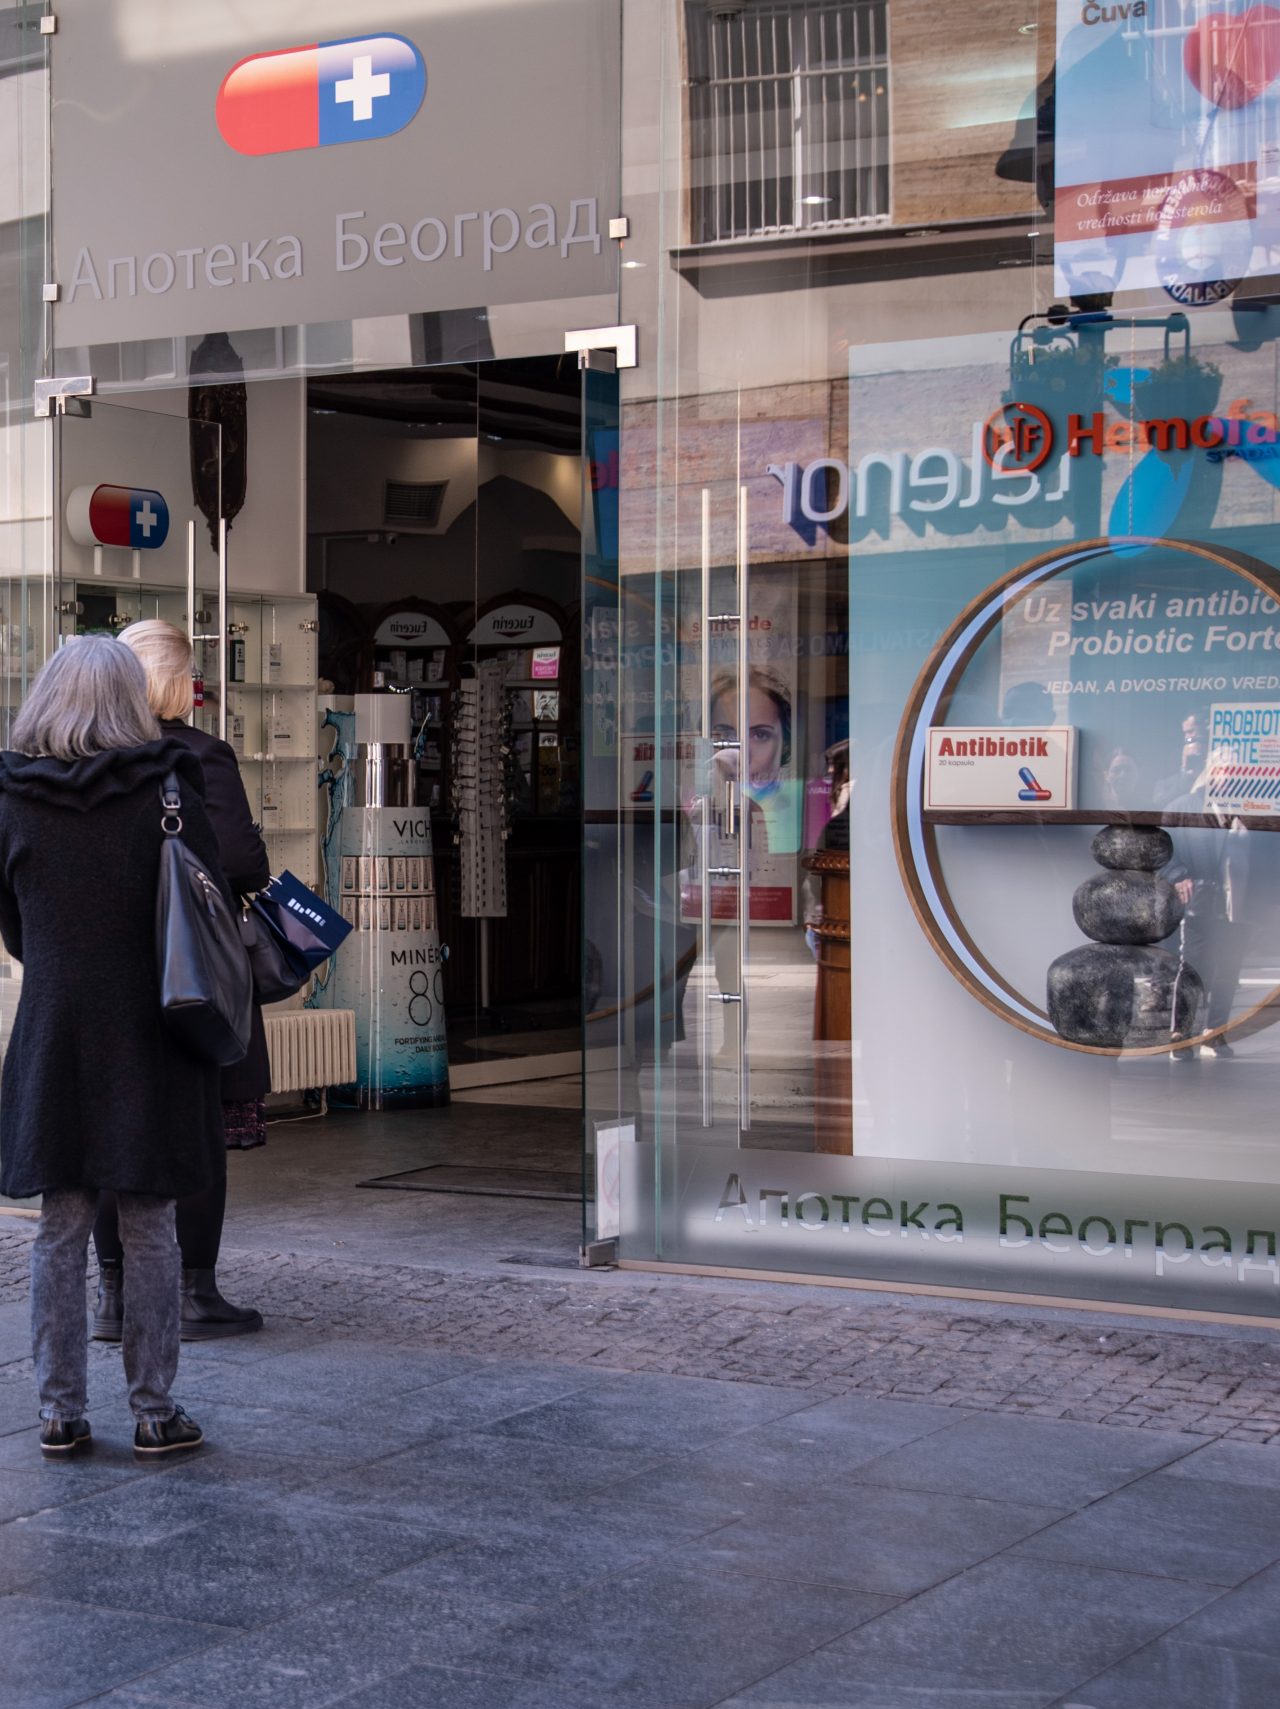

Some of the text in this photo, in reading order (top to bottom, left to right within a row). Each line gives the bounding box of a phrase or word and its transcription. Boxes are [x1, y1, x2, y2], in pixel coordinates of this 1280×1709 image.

[1077, 188, 1137, 208] Održava
[1078, 198, 1223, 231] vrednosti hosterola
[65, 197, 600, 303] Апотека Београд
[1023, 598, 1062, 623] Uz
[1071, 593, 1158, 622] svaki
[1047, 627, 1195, 657] Probiotic
[1042, 674, 1280, 696] JEDAN, A DVOSTRUKO VRED
[938, 737, 1048, 757] Antibiotik
[715, 1173, 1280, 1286] Апотека Београд
